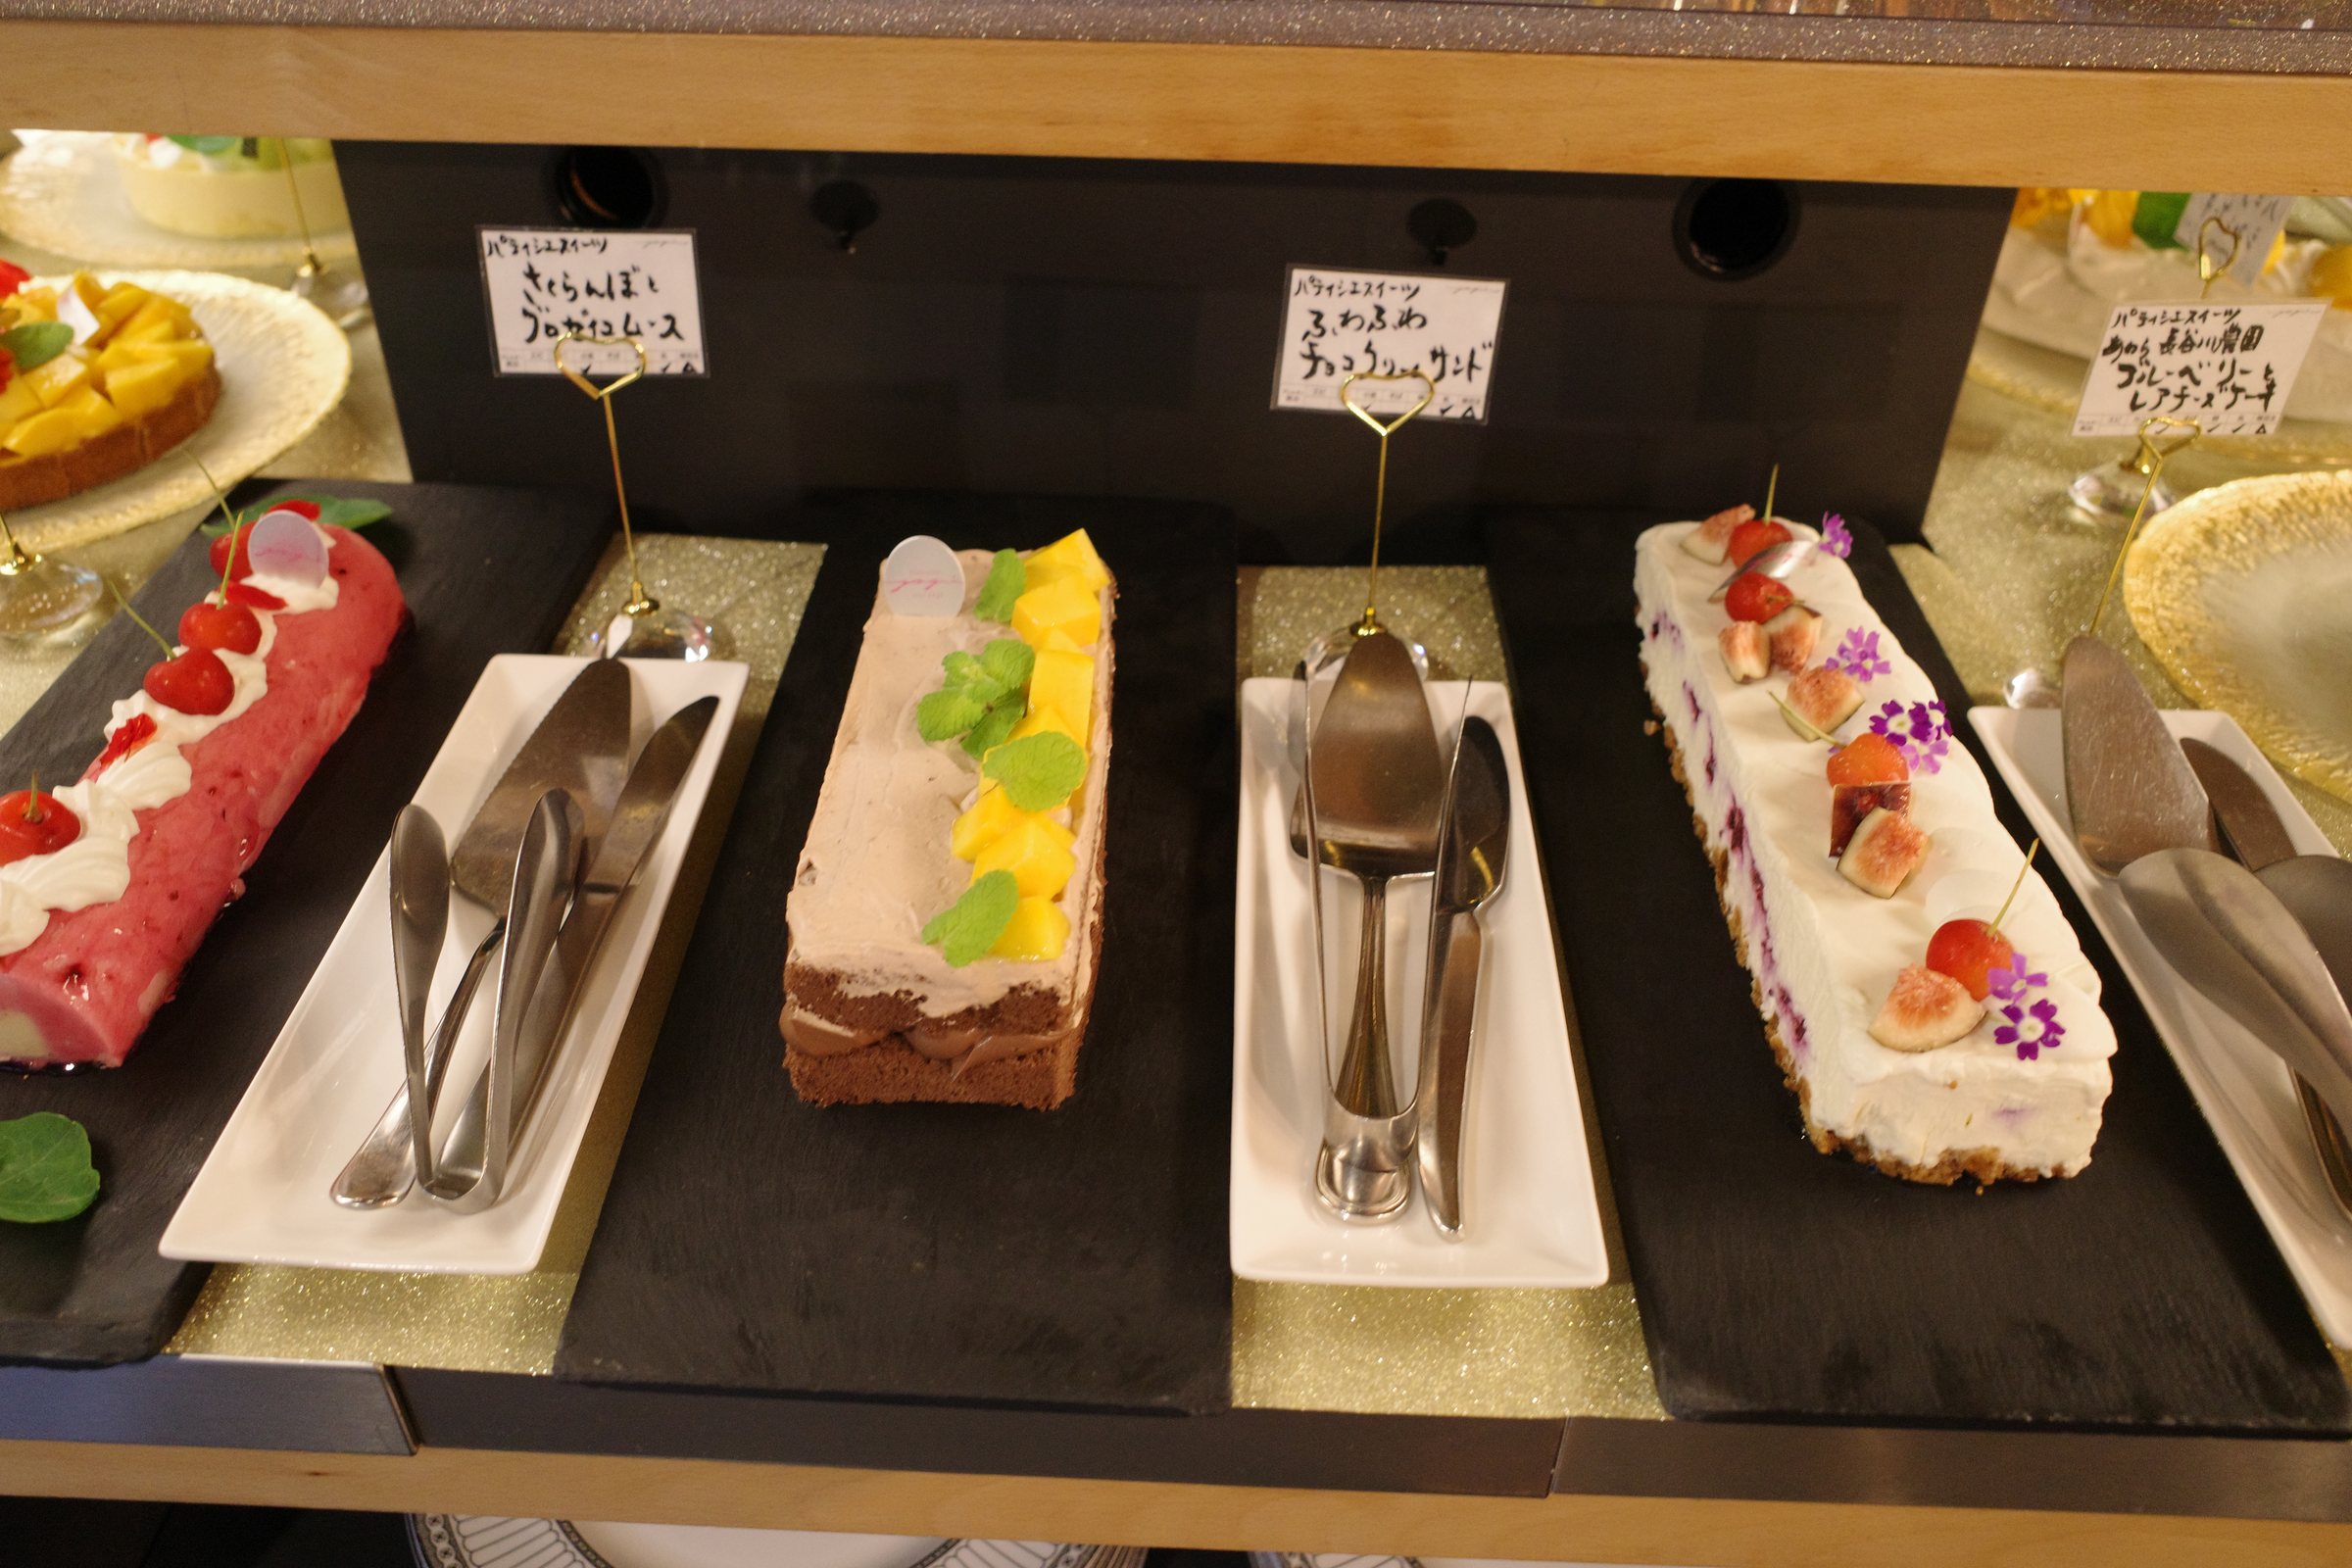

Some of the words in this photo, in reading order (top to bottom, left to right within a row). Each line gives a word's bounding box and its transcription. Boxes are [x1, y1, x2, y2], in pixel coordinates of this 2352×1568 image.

[487, 234, 608, 257] パティシエスイーツ
[523, 262, 659, 304] さくらんぼと
[1294, 275, 1421, 301] パティシエスイーツ
[1301, 304, 1427, 341] ふわふわ
[2112, 307, 2241, 327] パティシエスイーツ
[2117, 358, 2275, 389] ブルーベリーと
[2130, 378, 2277, 413] レアチーズケーキ
